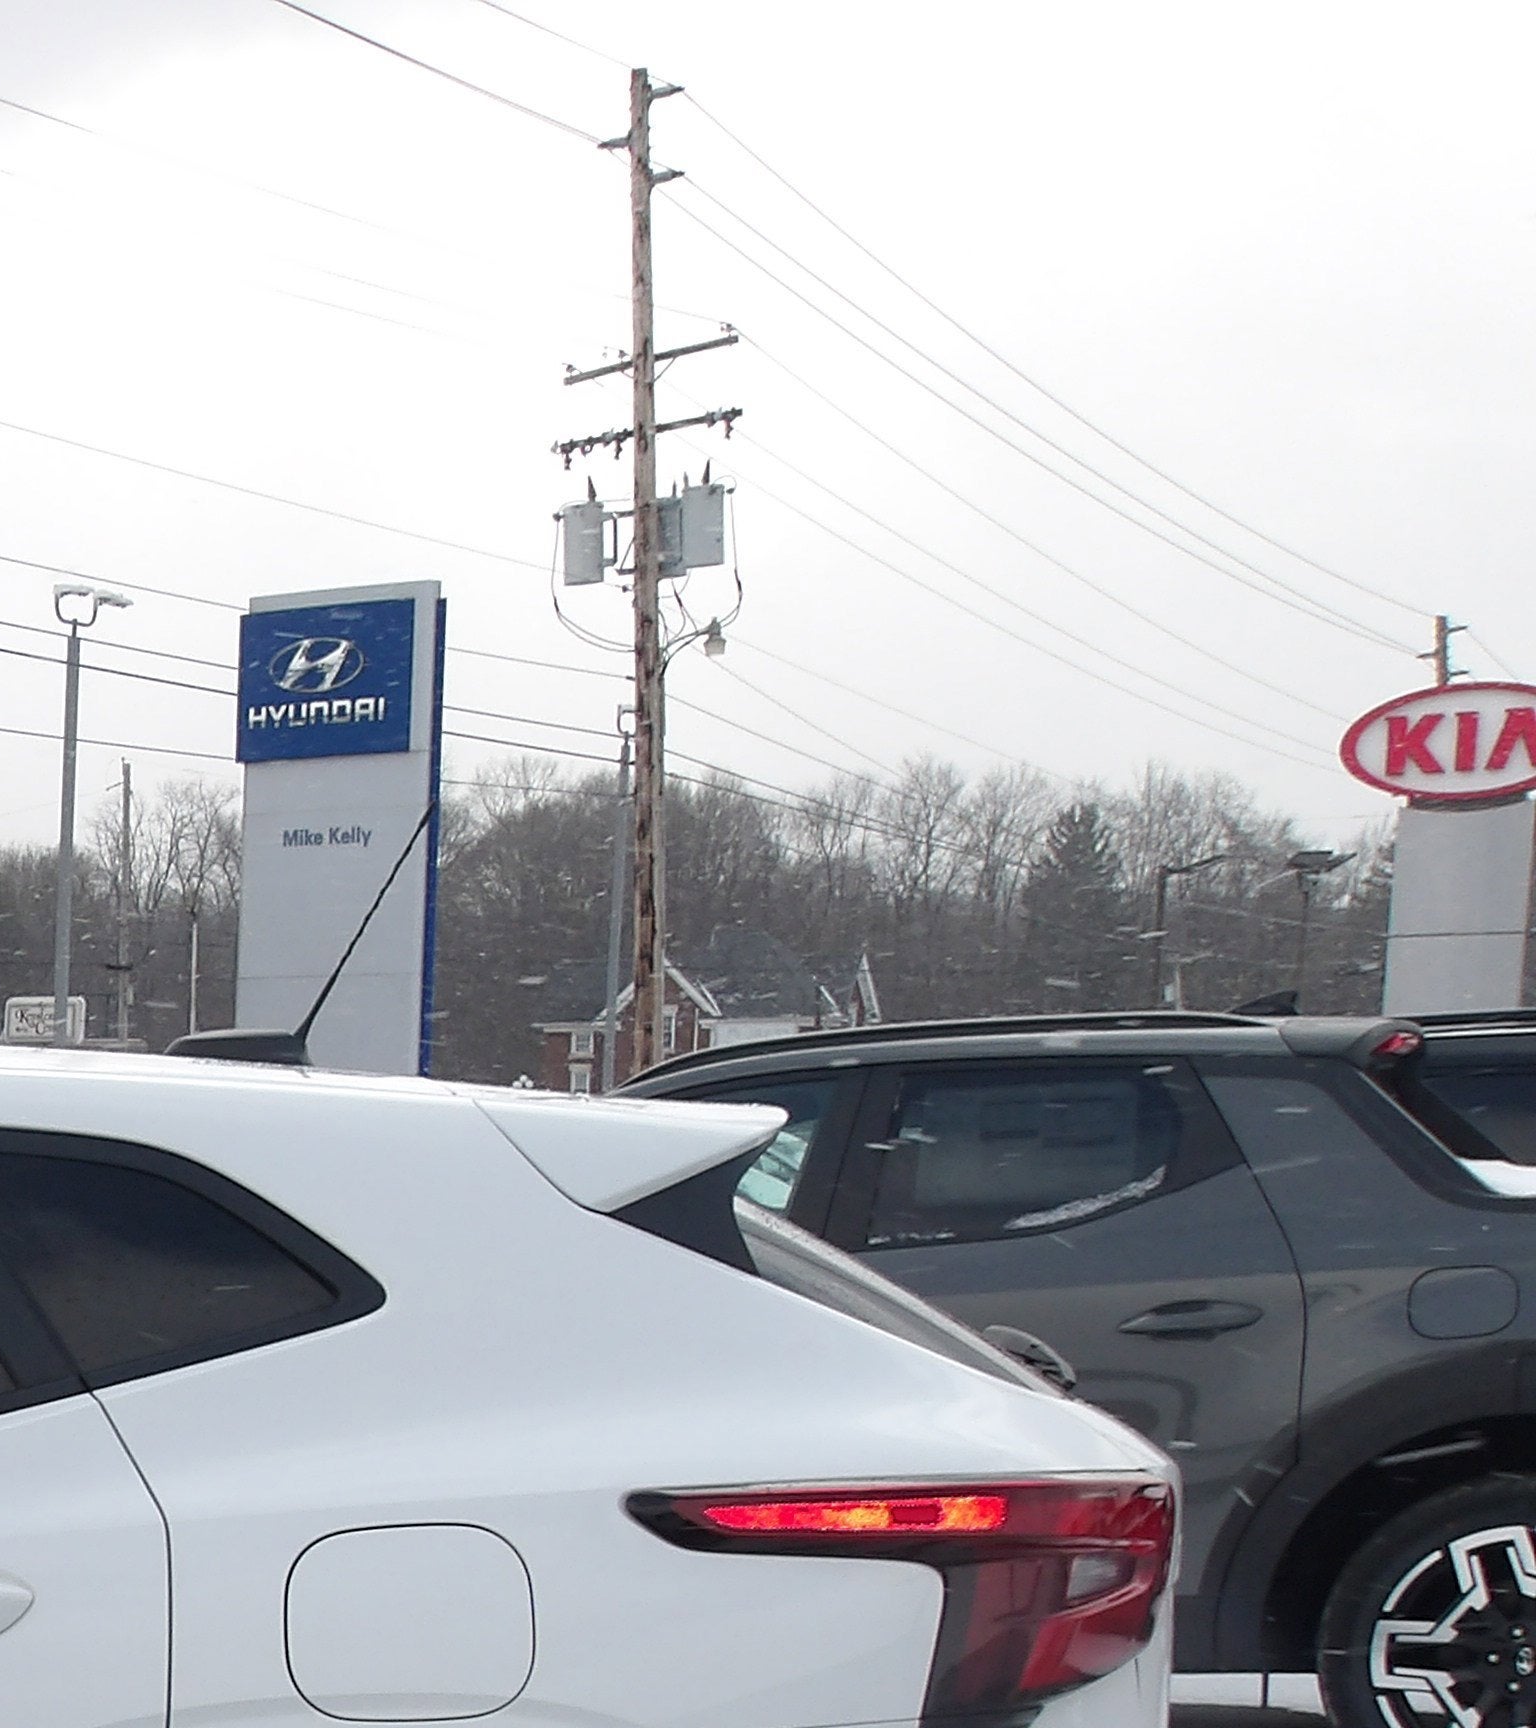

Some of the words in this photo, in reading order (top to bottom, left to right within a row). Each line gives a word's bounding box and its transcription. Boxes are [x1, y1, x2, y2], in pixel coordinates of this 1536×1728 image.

[247, 697, 385, 729] HYUNDAI
[1384, 707, 1536, 777] KIA
[283, 829, 323, 847] Mike
[328, 826, 372, 847] Kelly
